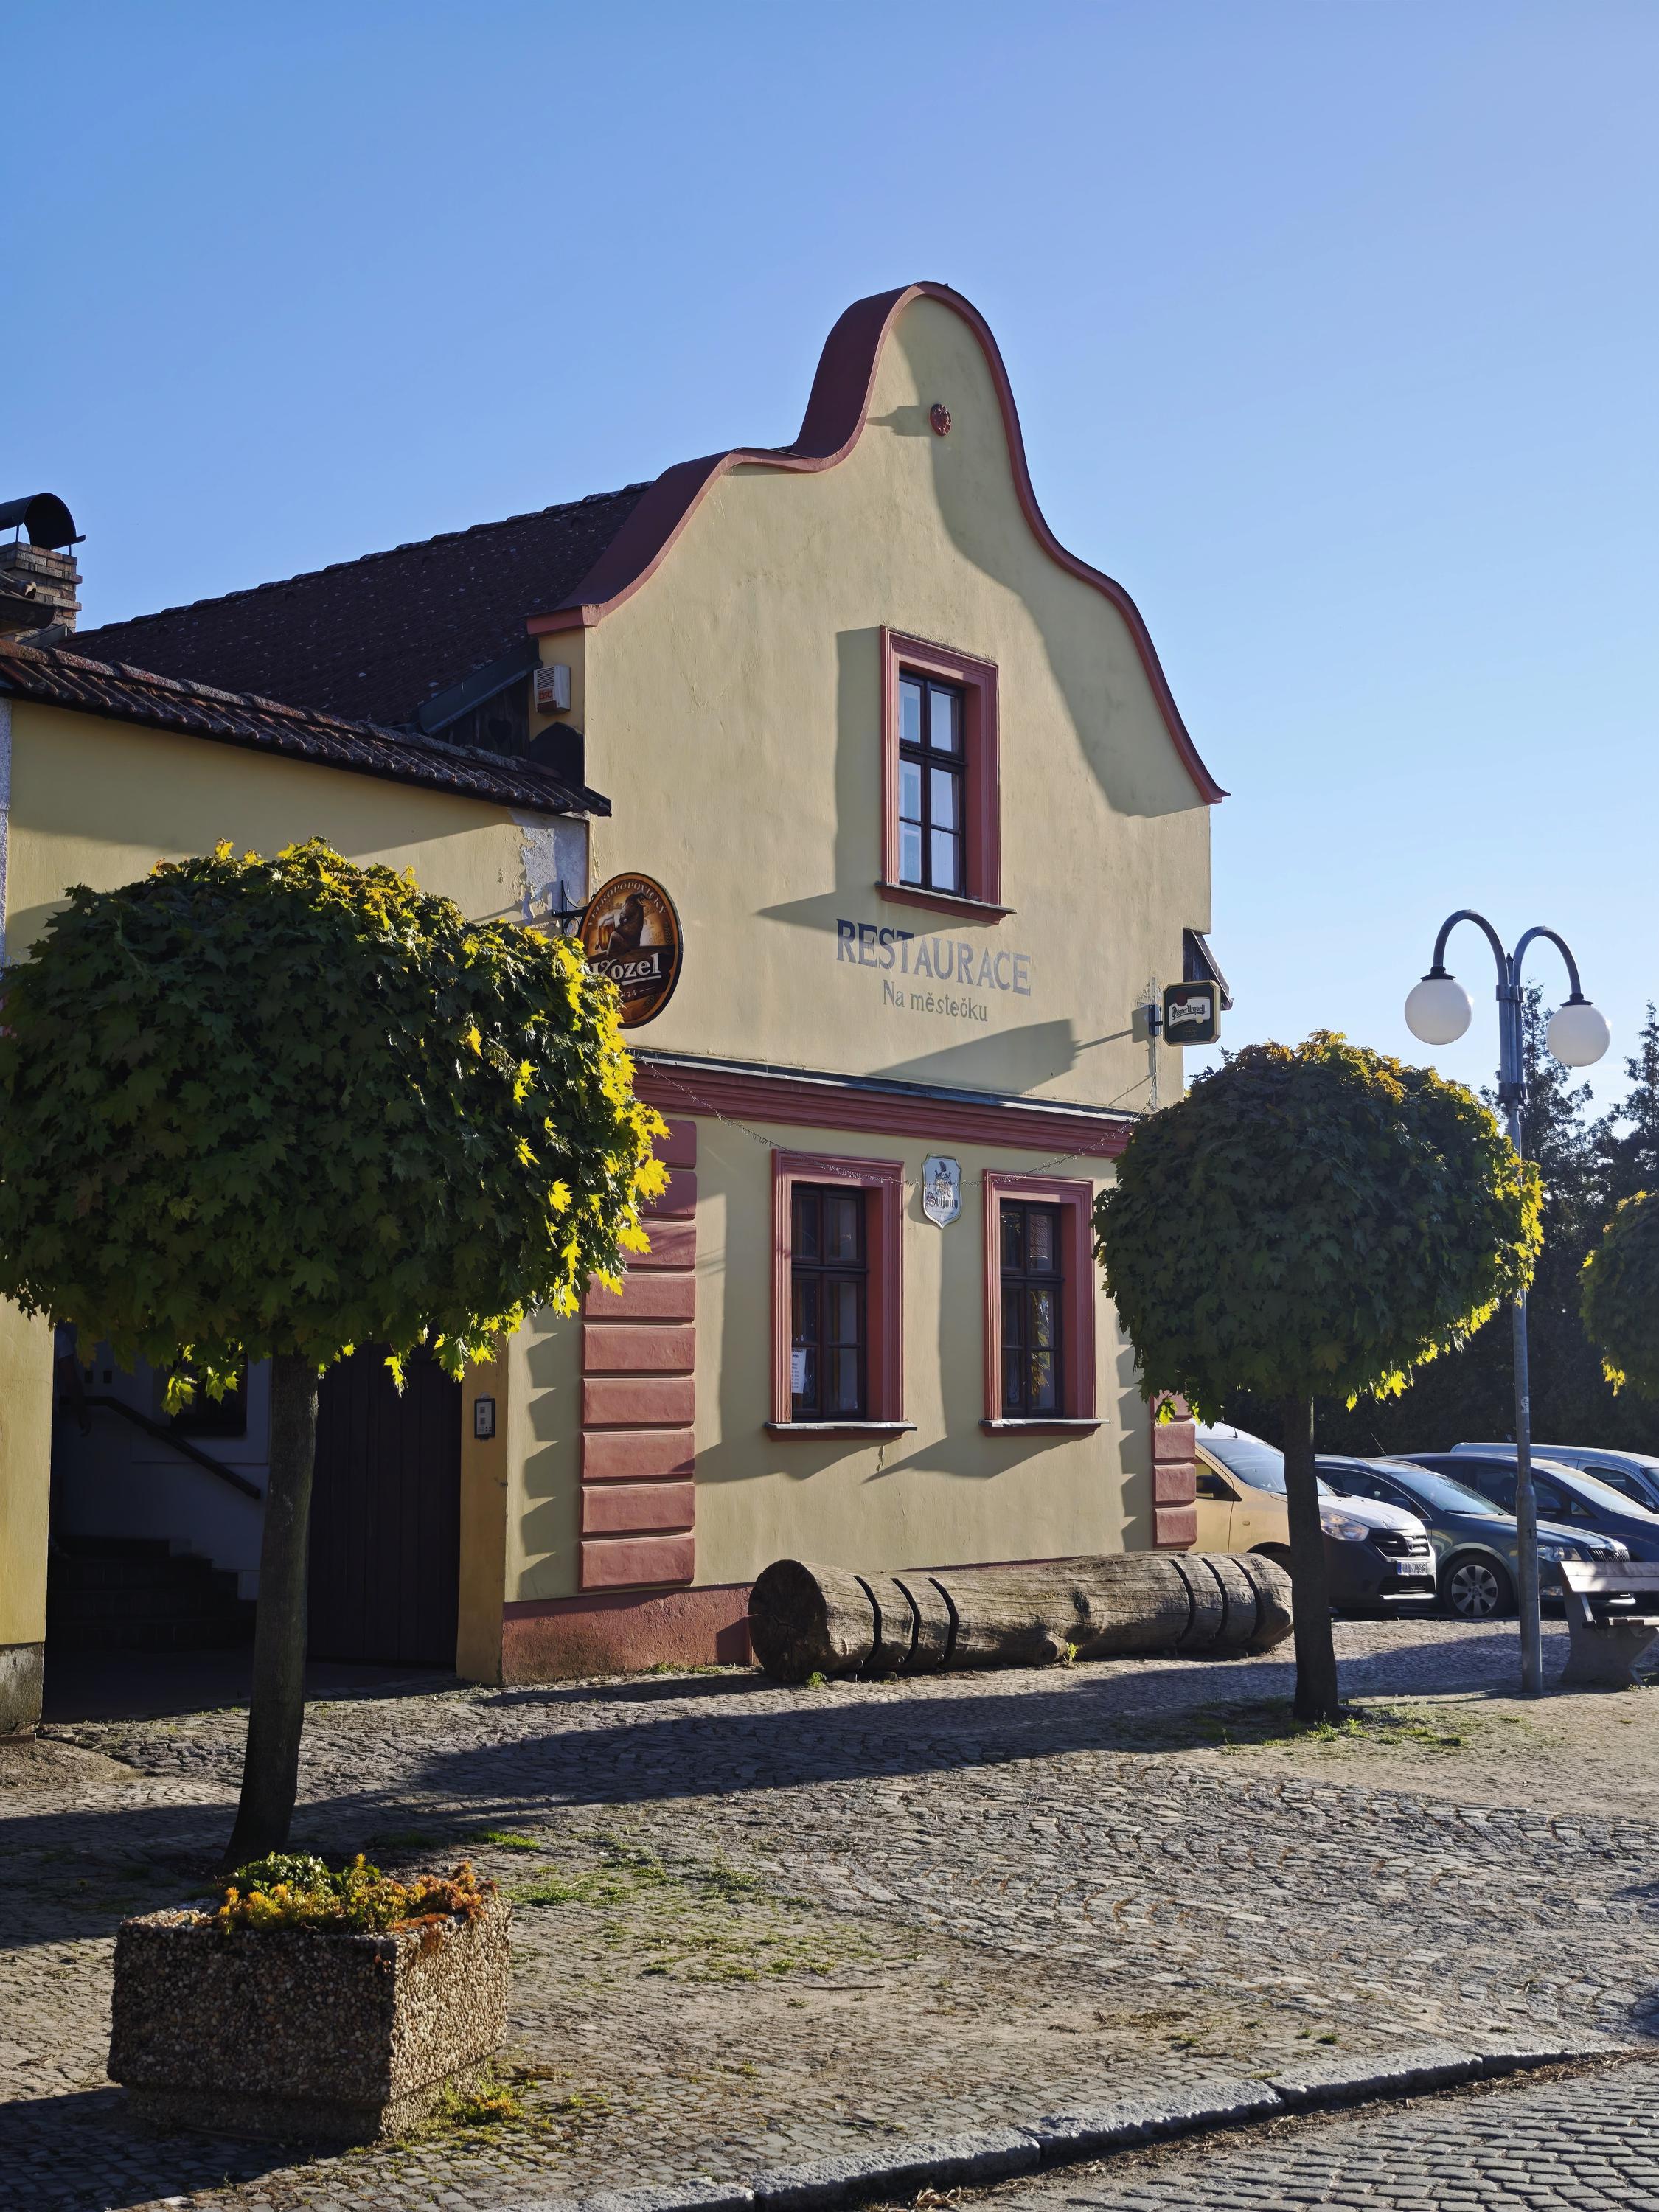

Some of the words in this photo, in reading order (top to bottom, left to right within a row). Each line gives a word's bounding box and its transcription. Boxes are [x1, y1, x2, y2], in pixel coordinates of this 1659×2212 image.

[591, 953, 661, 980] Kozel
[836, 919, 1031, 996] RESTAURACE
[883, 979, 905, 1008] Na
[910, 992, 988, 1022] městečku
[1172, 1006, 1187, 1020] Pilsner
[1186, 1004, 1206, 1015] Urquell
